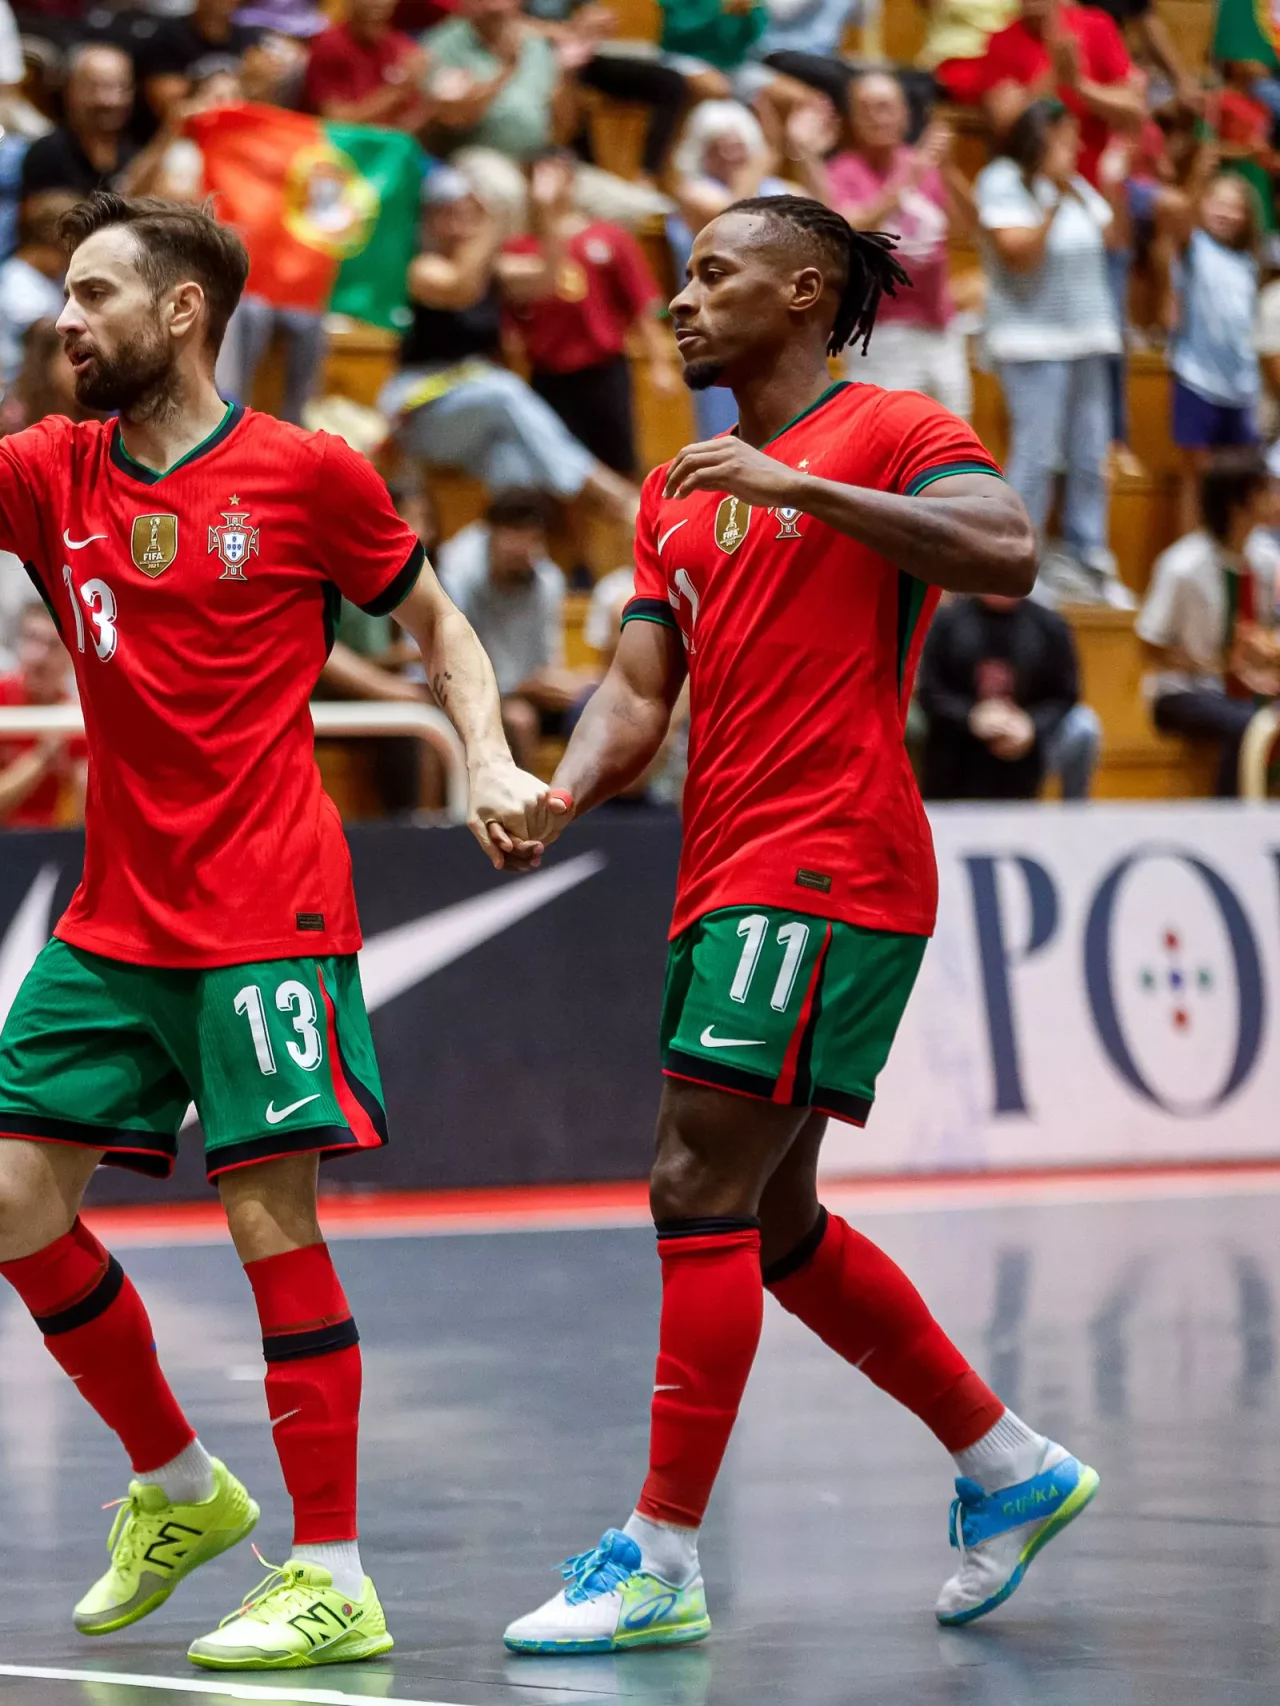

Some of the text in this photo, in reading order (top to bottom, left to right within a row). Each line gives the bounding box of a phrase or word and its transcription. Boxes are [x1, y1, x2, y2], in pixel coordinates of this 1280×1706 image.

[143, 552, 163, 561] FIFA
[62, 564, 118, 663] 13
[729, 914, 810, 1013] 11
[954, 840, 1280, 1123] PO
[233, 980, 323, 1076] 13
